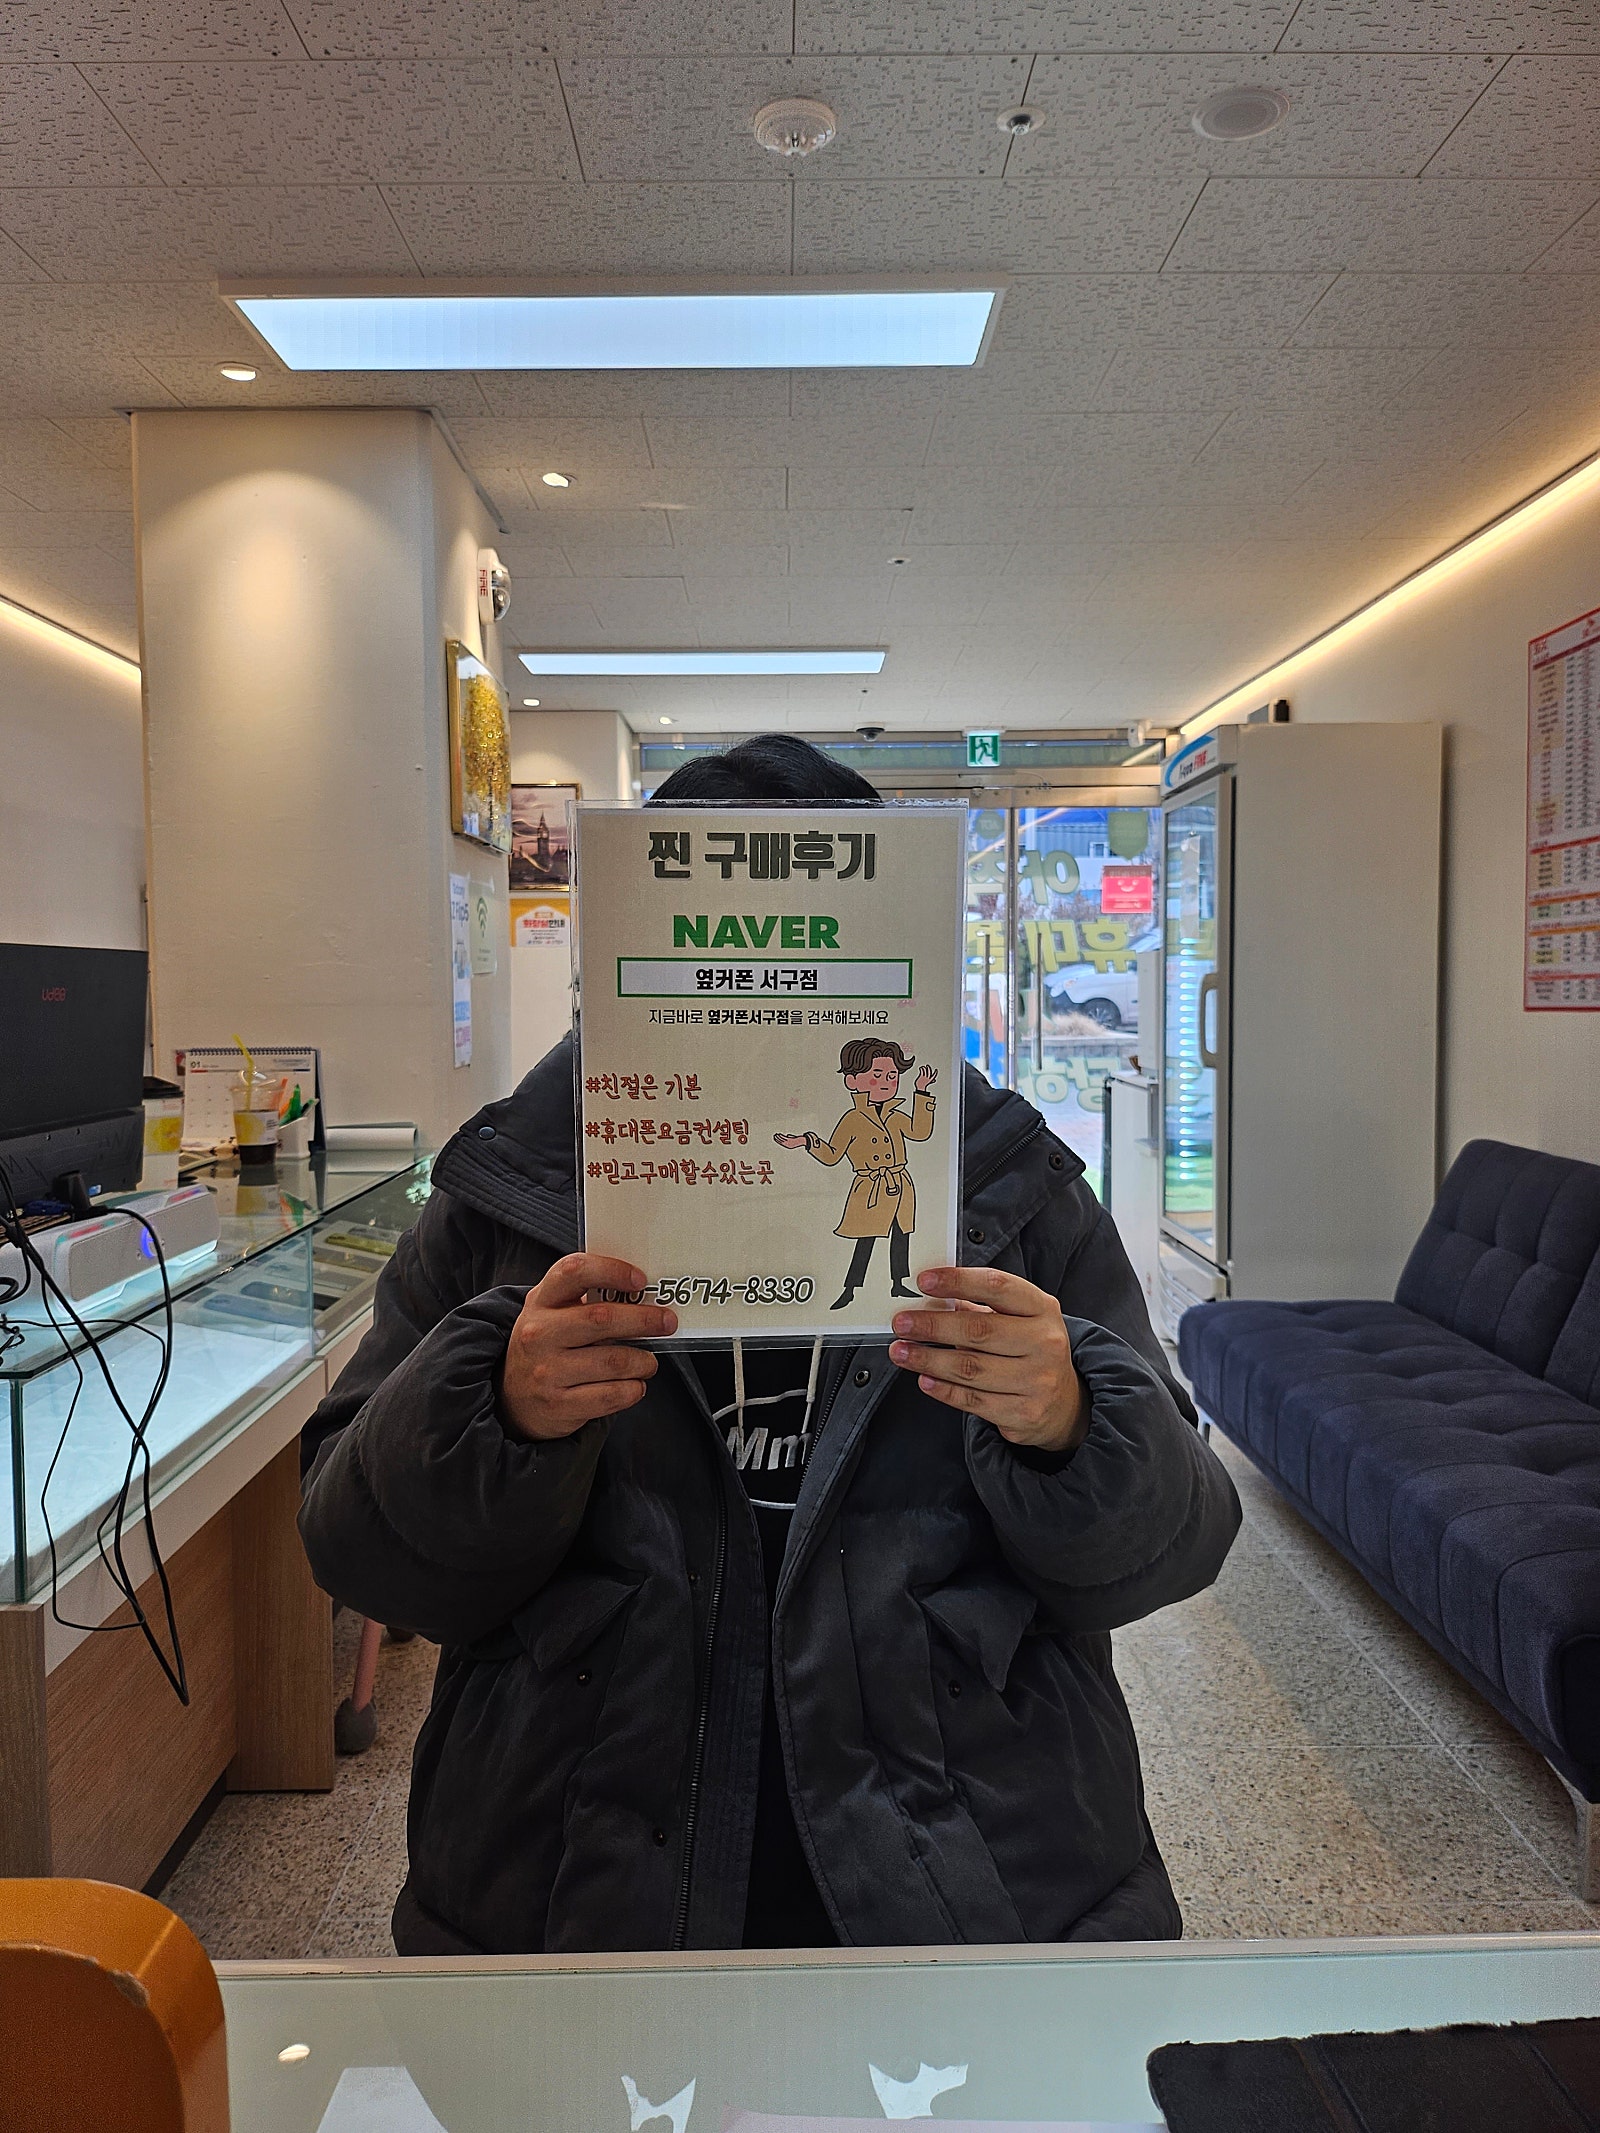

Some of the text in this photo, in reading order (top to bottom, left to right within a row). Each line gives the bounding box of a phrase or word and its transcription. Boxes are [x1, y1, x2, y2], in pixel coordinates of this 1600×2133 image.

[480, 569, 488, 597] FIRE
[649, 830, 876, 880] 찐 구매후기
[673, 914, 841, 949] NAVER
[695, 968, 818, 991] 옆커폰 서구점
[648, 1009, 889, 1026] 지금바로 옆커폰서구점을 검색해보세요
[585, 1073, 702, 1100] #친절은 기본
[585, 1118, 749, 1145] #휴대폰요금컨설팅
[587, 1158, 775, 1186] #믿고구매할수있는곳
